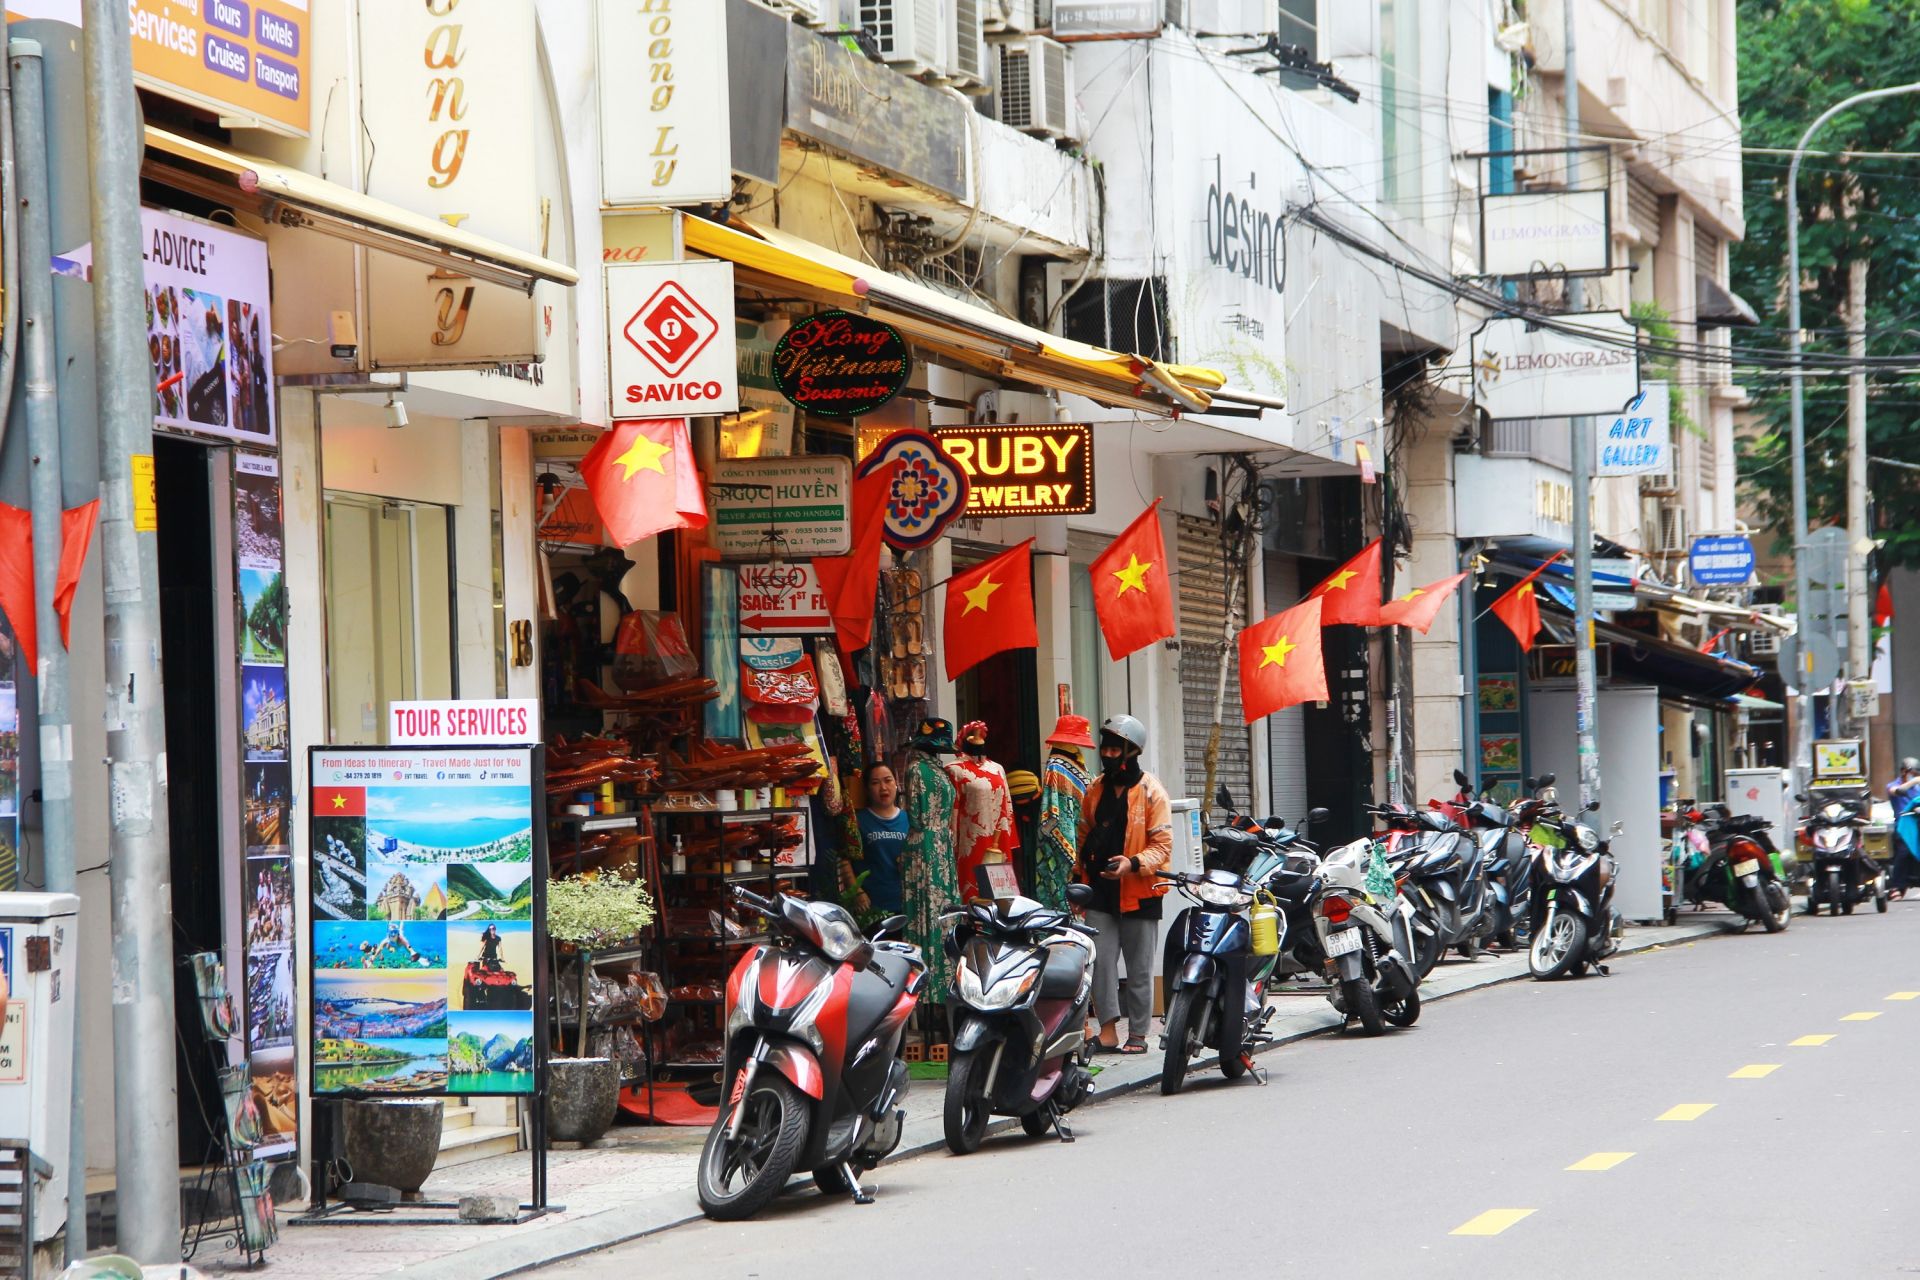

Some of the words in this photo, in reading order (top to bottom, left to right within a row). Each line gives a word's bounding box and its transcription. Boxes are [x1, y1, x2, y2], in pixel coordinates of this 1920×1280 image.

[213, 0, 241, 29] Tours
[261, 15, 293, 49] Hotels
[207, 39, 246, 73] Cruises
[256, 58, 298, 93] Transport
[649, 126, 679, 187] Ly
[1207, 153, 1287, 294] desino
[1491, 223, 1601, 242] LEMONGRASS
[1505, 350, 1631, 371] LEMONGRASS
[626, 381, 723, 403] SAVICO
[558, 434, 578, 443] Minh
[1609, 417, 1653, 439] ART
[942, 435, 1079, 476] RUBY
[1603, 444, 1660, 467] GALLERY
[722, 466, 744, 478] CÔNG
[758, 469, 779, 477] TNHH
[780, 468, 797, 476] MTV
[813, 466, 836, 476] NGHỆ
[777, 477, 839, 499] HUYỀN
[967, 484, 1071, 507] EWELRY
[720, 512, 748, 521] SILVER
[784, 510, 801, 518] AND
[803, 509, 841, 517] HANDBAG
[795, 526, 812, 534] 0935
[814, 526, 828, 534] 003
[829, 525, 843, 533] 589
[812, 537, 837, 546] Tphcm
[750, 656, 792, 667] Classic
[395, 709, 441, 737] TOUR
[447, 707, 527, 736] SERVICES
[322, 758, 342, 768] From
[344, 758, 366, 768] Ideas
[368, 758, 377, 768] to
[379, 758, 413, 769] Itinerary
[422, 758, 447, 768] Travel
[449, 758, 471, 768] Made
[473, 757, 491, 768] Just
[493, 757, 505, 767] for
[507, 757, 521, 767] You
